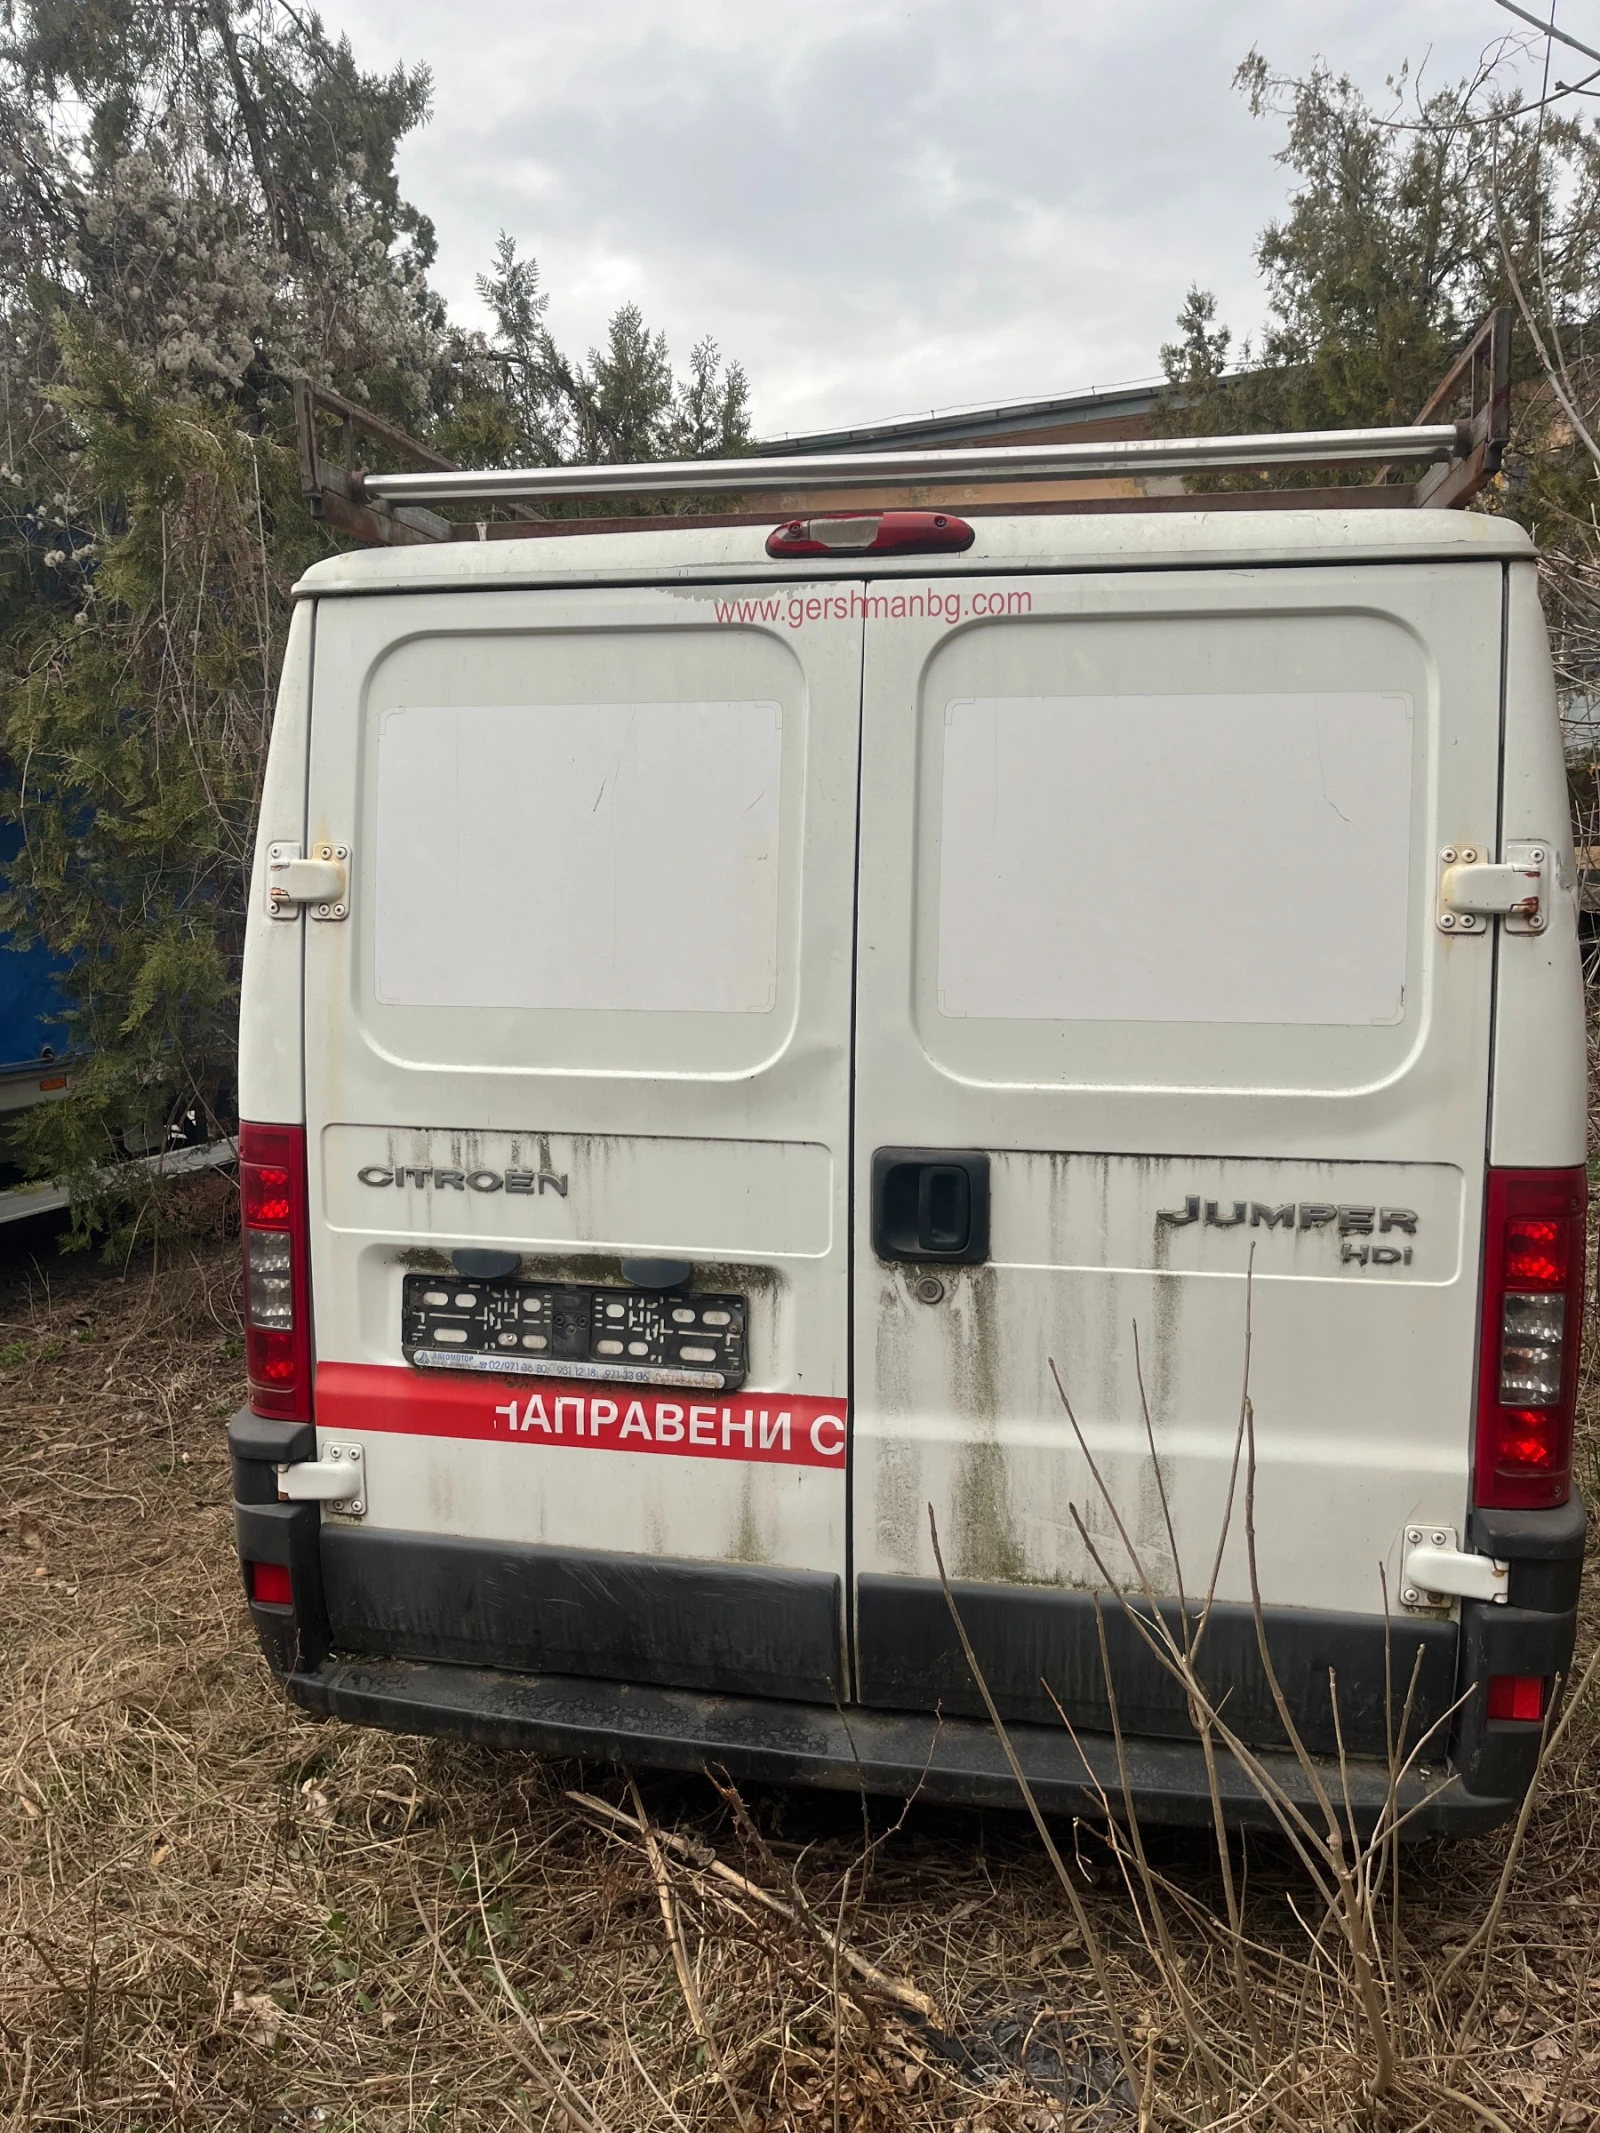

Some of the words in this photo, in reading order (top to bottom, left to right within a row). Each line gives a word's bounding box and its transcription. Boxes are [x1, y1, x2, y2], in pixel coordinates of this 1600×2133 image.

[714, 588, 1033, 629] www.gershmanbg.com
[357, 1163, 568, 1198] CITROËN
[1156, 1194, 1419, 1233] JUMPER
